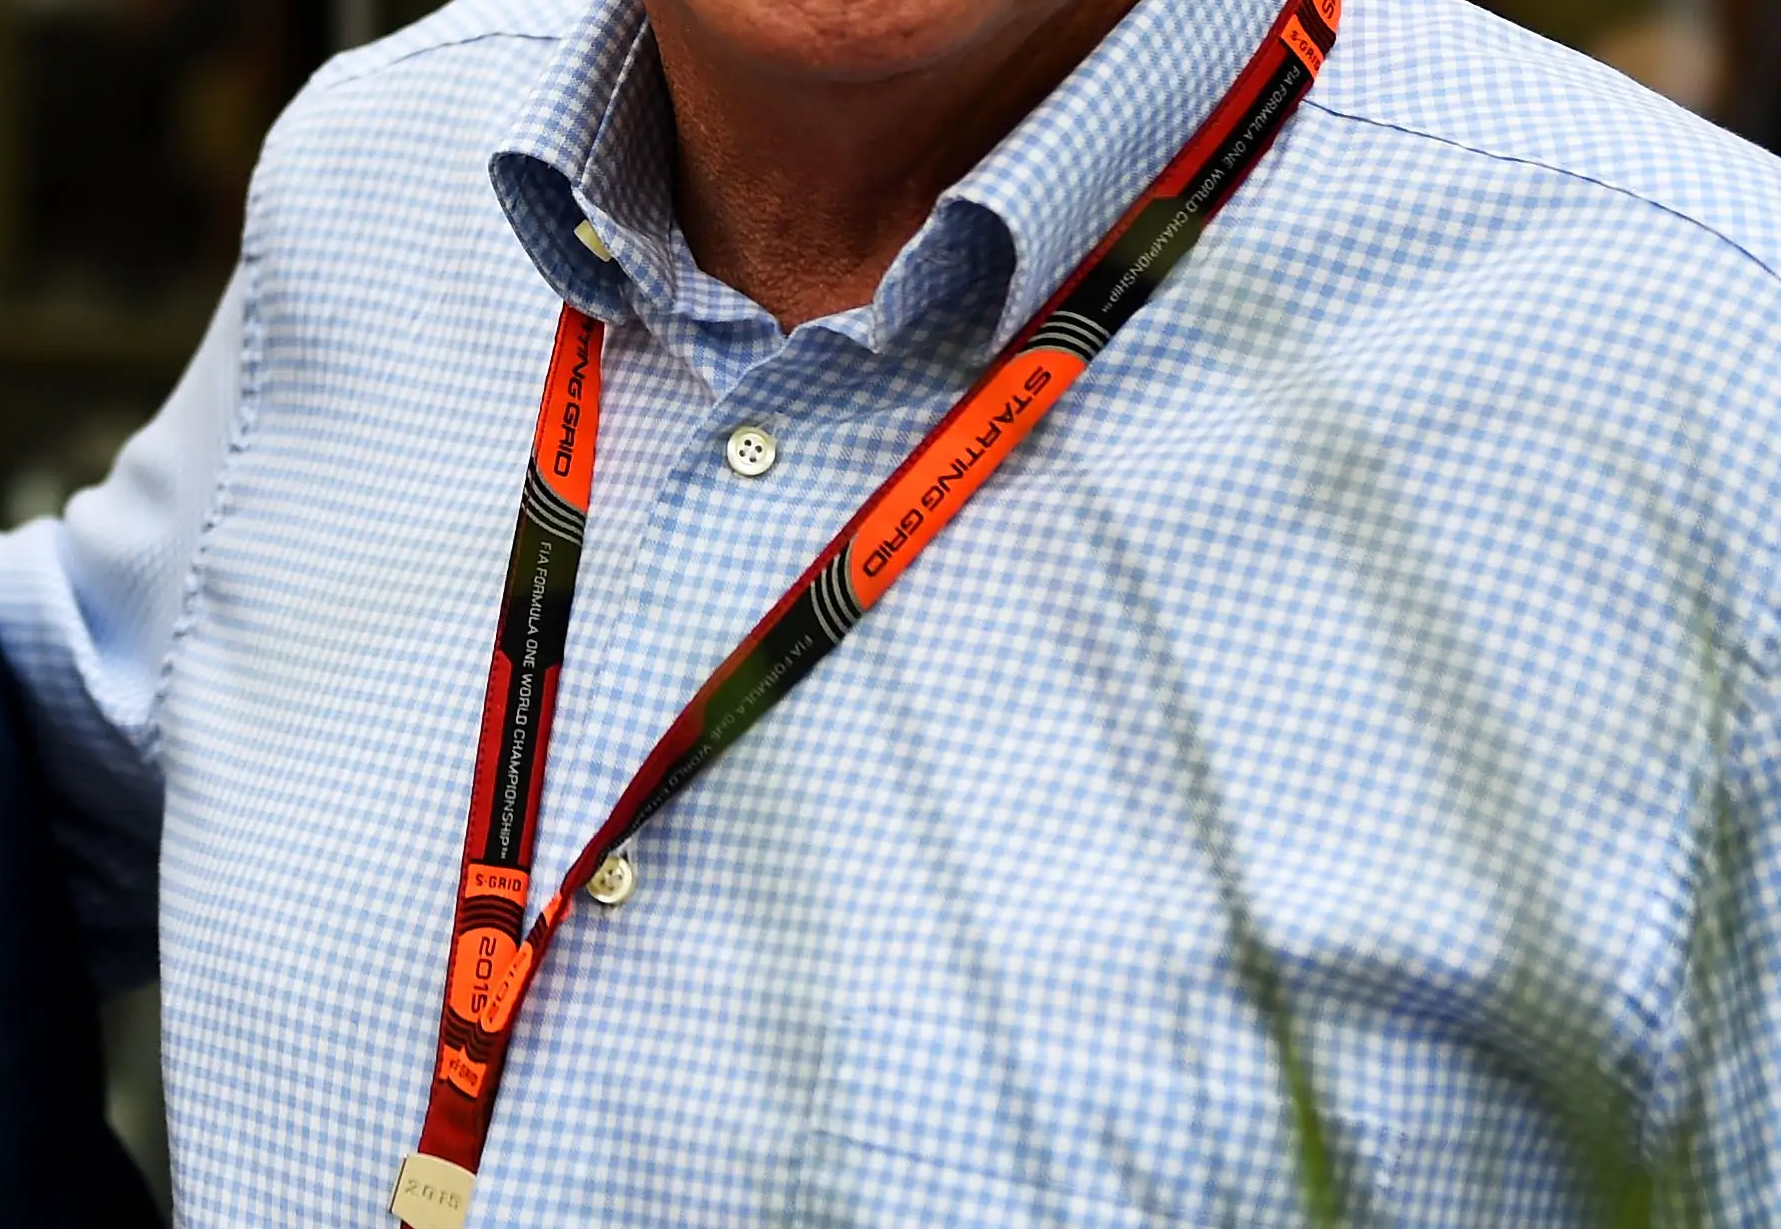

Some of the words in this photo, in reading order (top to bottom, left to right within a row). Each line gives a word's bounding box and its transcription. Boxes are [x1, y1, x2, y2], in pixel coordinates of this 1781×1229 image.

[1285, 64, 1301, 86] FIA
[1243, 85, 1289, 140] FORMULA
[1221, 140, 1247, 168] ONE
[1186, 168, 1226, 215] WORLD
[553, 401, 581, 477] GRID
[919, 365, 1052, 513] STARTING
[538, 540, 553, 565] FIA
[862, 509, 925, 579] GRID
[528, 566, 547, 635] FORMULA
[523, 639, 538, 669] ONE
[515, 674, 533, 725] WORLD
[475, 874, 522, 892] S-GRID
[471, 936, 496, 1014] 2015
